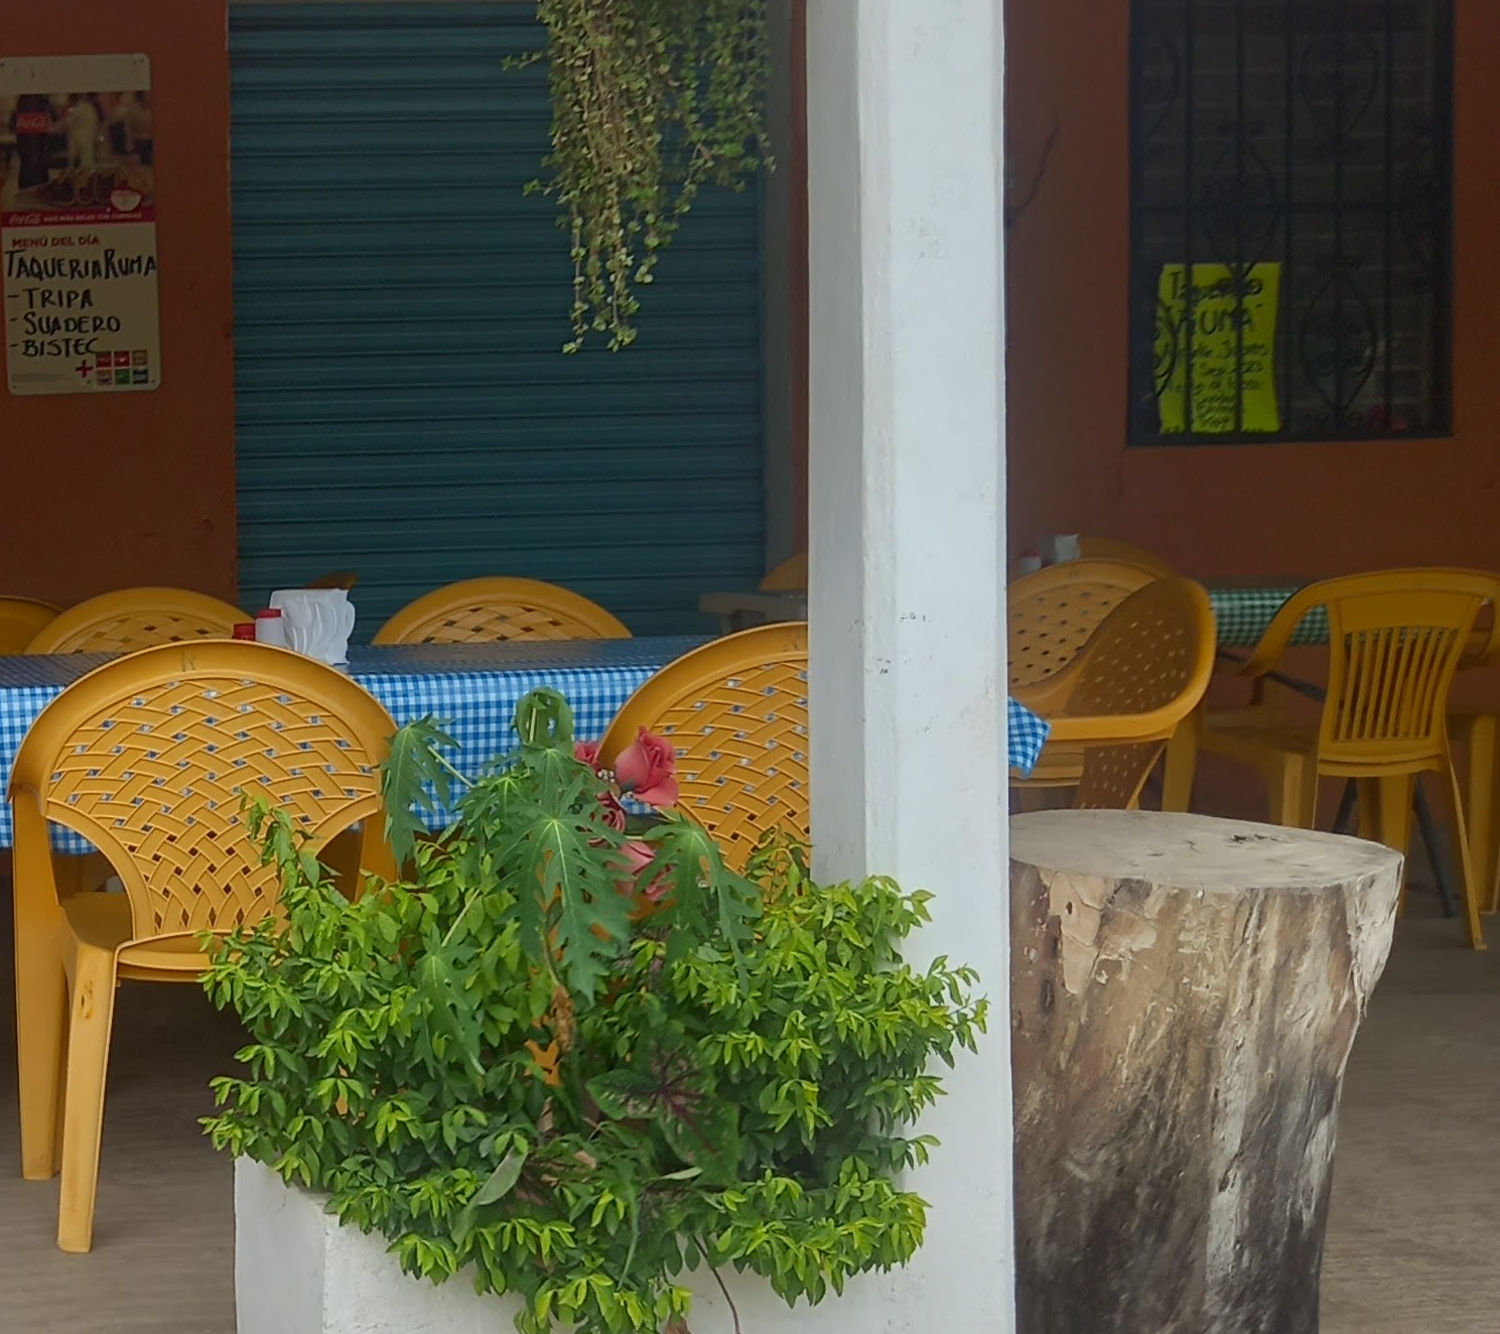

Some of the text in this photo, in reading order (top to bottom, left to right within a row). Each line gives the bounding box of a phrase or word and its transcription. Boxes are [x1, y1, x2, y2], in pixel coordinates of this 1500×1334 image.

[12, 233, 100, 248] MENÚ DEL DÍA
